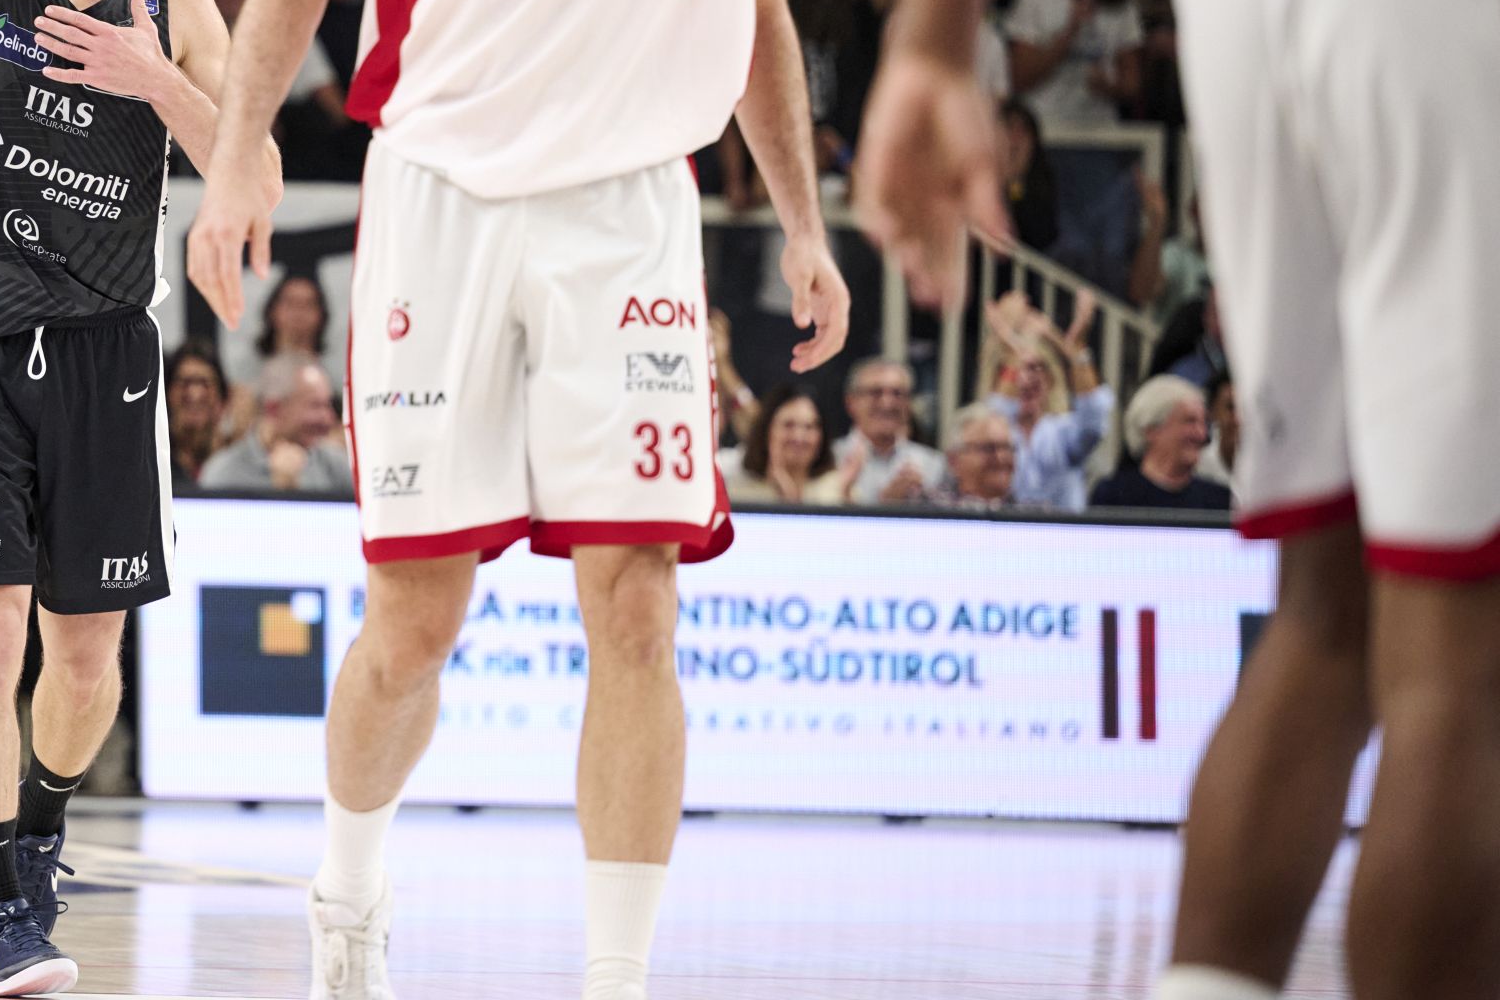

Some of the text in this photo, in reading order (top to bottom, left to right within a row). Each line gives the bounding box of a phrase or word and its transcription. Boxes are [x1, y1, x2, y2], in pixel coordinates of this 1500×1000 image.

[24, 84, 95, 129] ITAS
[23, 111, 89, 139] ASSICURAZIONI
[3, 144, 131, 202] Dolomiti
[40, 187, 123, 221] energia
[618, 296, 696, 329] AON
[634, 420, 695, 482] 33
[372, 463, 421, 490] EA7
[100, 550, 149, 581] ITAS
[100, 573, 151, 589] ASSICURAONI
[949, 601, 1082, 638] ADIGE
